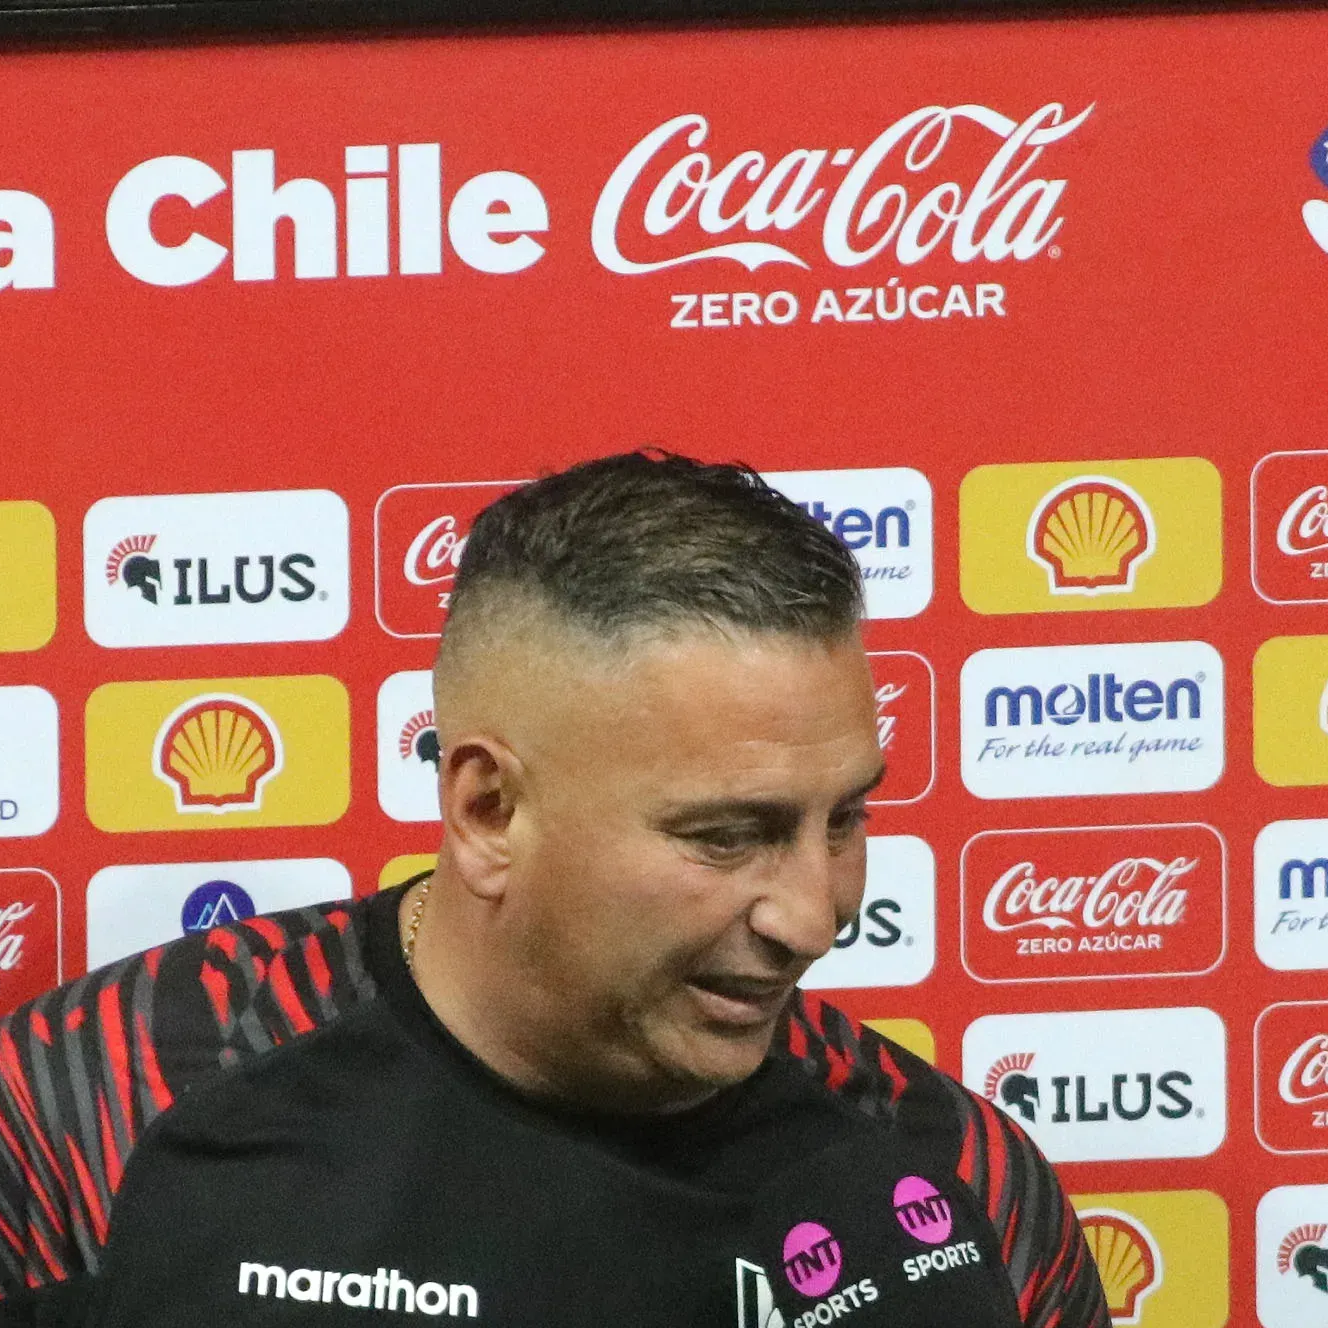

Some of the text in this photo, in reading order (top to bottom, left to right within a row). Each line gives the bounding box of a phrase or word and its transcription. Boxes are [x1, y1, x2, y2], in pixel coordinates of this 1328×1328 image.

[591, 103, 1095, 275] Coca-Cola
[106, 143, 549, 287] Chile
[670, 277, 1006, 328] ZERO AZÚCAR
[174, 553, 315, 605] ILUS
[861, 565, 912, 580] ame
[985, 674, 1200, 727] molten
[977, 731, 1203, 763] For the real game
[982, 857, 1198, 933] Coca-Cola
[1017, 932, 1162, 955] ZERO AZÚCAR
[1270, 910, 1316, 934] For
[1052, 1071, 1192, 1123] ILUS
[893, 1193, 951, 1230] TNT
[783, 1236, 838, 1285] TNT
[903, 1241, 981, 1281] SPORTS
[239, 1262, 478, 1317] marathon
